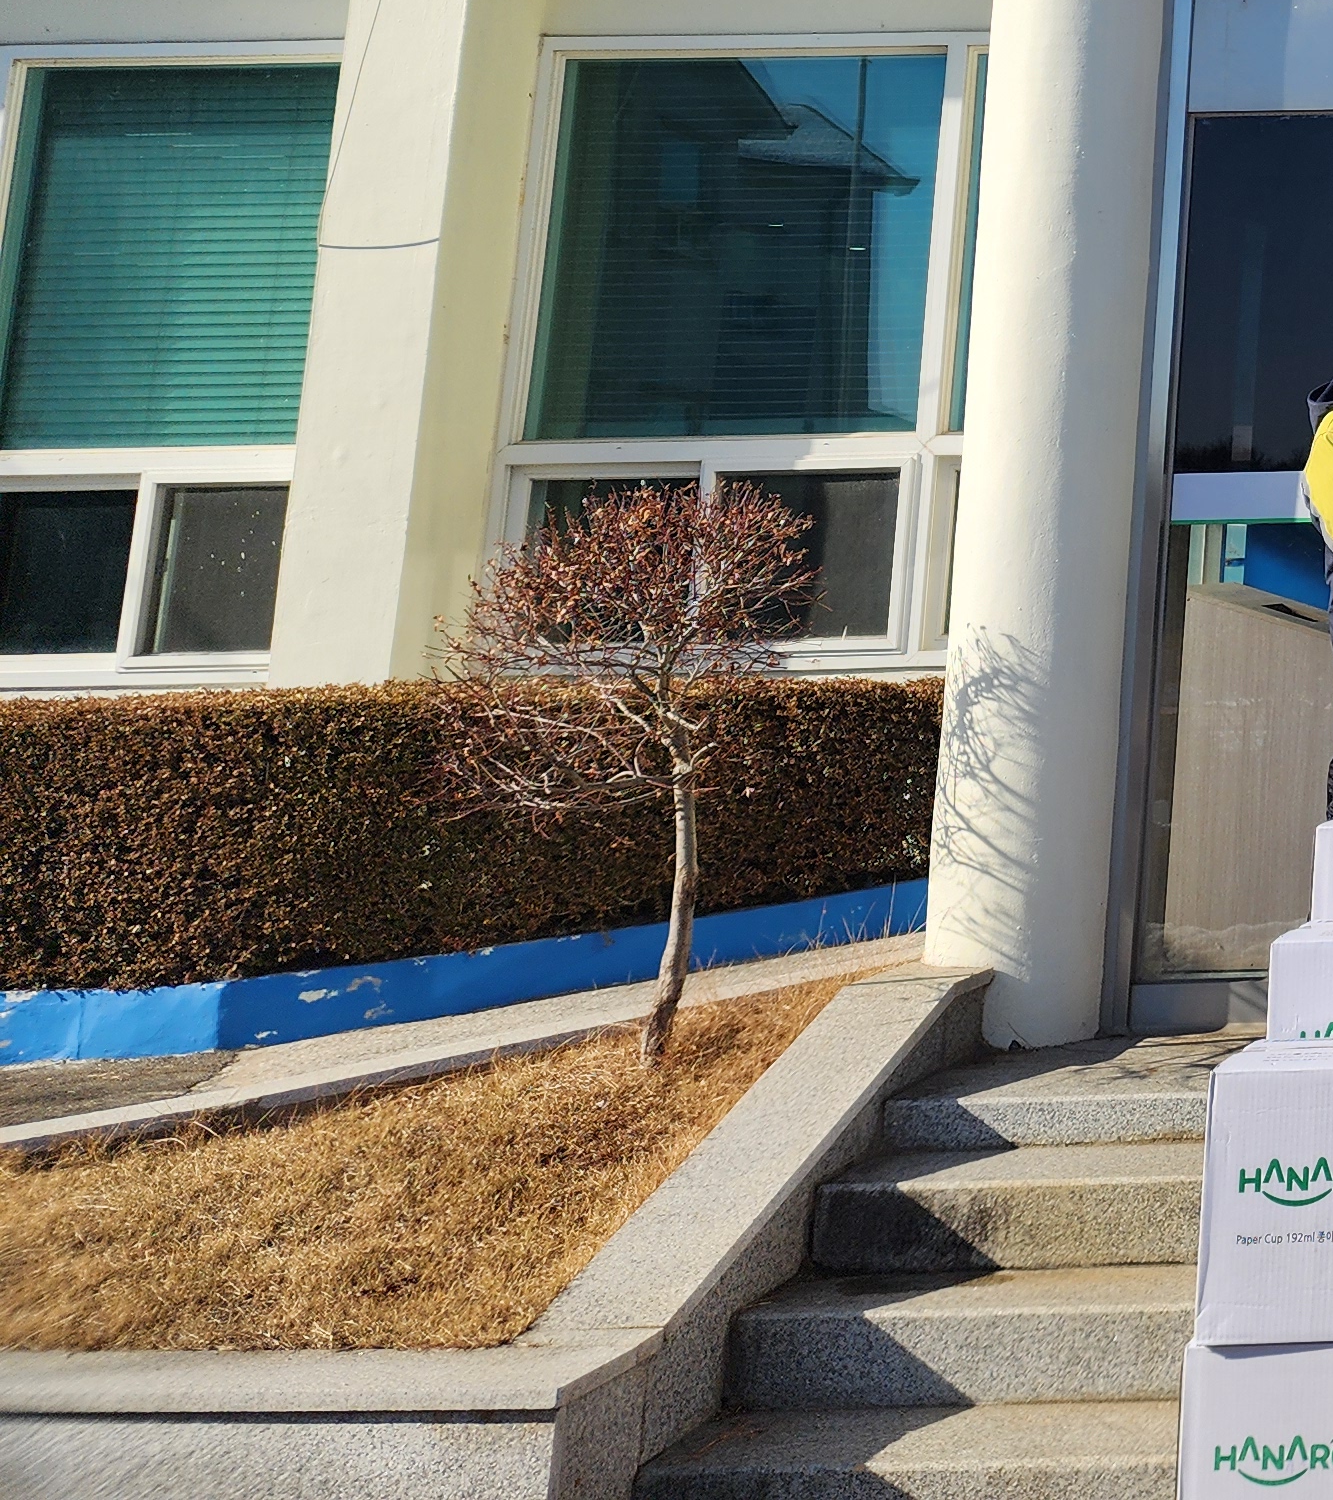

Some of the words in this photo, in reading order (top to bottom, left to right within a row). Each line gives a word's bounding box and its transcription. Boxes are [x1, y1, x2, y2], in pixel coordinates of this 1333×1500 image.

[1236, 1234, 1263, 1245] Paper
[1264, 1233, 1283, 1245] Cup
[1286, 1231, 1316, 1243] 192ml
